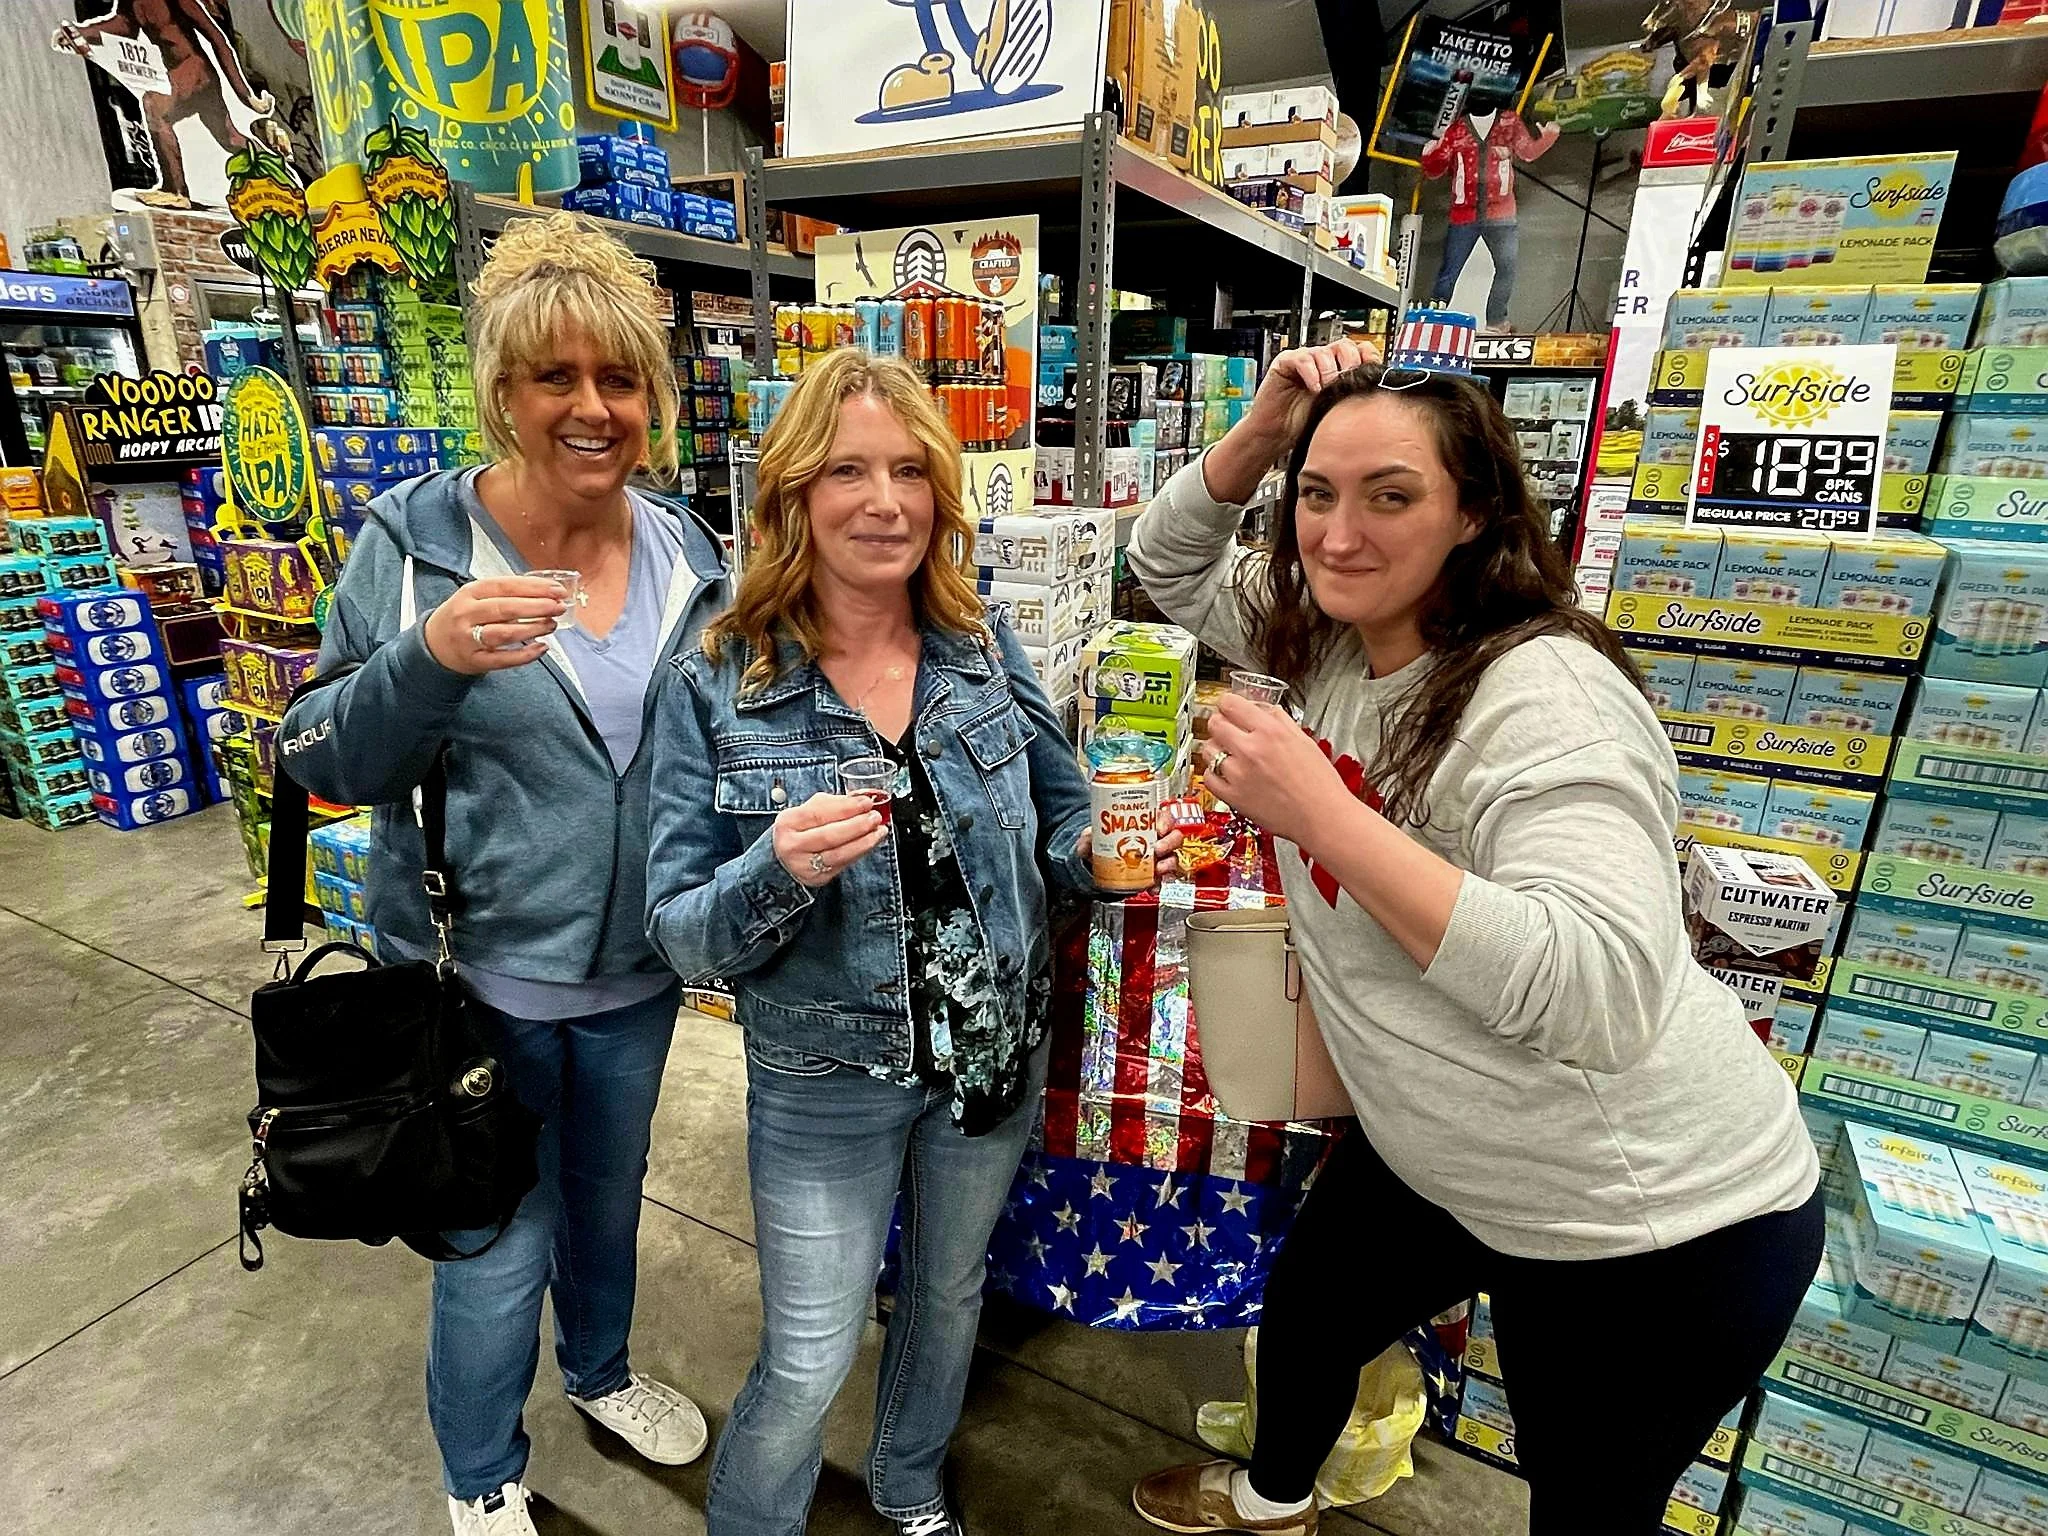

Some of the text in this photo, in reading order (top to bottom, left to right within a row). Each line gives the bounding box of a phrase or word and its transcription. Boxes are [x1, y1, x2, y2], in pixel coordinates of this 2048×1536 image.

[119, 40, 150, 64] 1812
[1440, 31, 1476, 52] TAKE
[1476, 40, 1493, 55] IT
[1492, 43, 1513, 59] TO
[380, 0, 537, 112] IPA
[1431, 46, 1512, 75] THE HOUSE
[1438, 82, 1461, 129] TRULY
[377, 171, 438, 192] SIERRA NEVADA
[1851, 177, 1948, 208] Surfside
[318, 229, 358, 259] SIERRA
[1839, 237, 1933, 249] LEMONADE PACK
[979, 258, 1012, 269] CRAFTED
[1624, 269, 1641, 288] R
[1675, 315, 1760, 325] LEMONADE PACK
[1771, 314, 1860, 324] LEMONADE PACK
[1872, 313, 1967, 324] LEMONADE PACK
[2008, 308, 2048, 318] GREEN
[99, 375, 214, 406] VOODOO
[1724, 374, 1870, 406] Surfside
[81, 407, 199, 441] RANGER
[242, 409, 285, 442] HAZY
[120, 440, 171, 459] HOPPY
[1900, 439, 1931, 448] PACK
[1967, 443, 2033, 452] GREEN TEA
[1700, 432, 1717, 488] SALE
[243, 453, 289, 503] IPA
[1825, 479, 1856, 491] 8PK
[1815, 491, 1863, 504] CANS
[1697, 508, 1753, 521] REGULAR
[1755, 510, 1791, 522] PRICE
[1020, 536, 1047, 558] 15
[1624, 557, 1712, 570] LEMONADE PACK
[1724, 563, 1819, 578] LEMONADE PACK
[1832, 571, 1933, 587] LEMONADE PACK
[1959, 582, 2027, 595] GREEN TEA
[1017, 599, 1044, 620] 15
[1657, 603, 1762, 634] Surfside
[1789, 615, 1875, 630] LEMONADE PACK
[1143, 671, 1173, 692] 15
[1657, 676, 1686, 686] PACK
[1696, 681, 1786, 697] LEMONADE PACK
[1142, 693, 1169, 706] PACK
[1799, 692, 1895, 711] LEMONADE PACK
[1922, 705, 2022, 723] GREEN TEA PACK
[1756, 731, 1837, 758] Surfside
[1111, 801, 1150, 812] ORANGE
[1730, 797, 1759, 810] PACK
[1100, 809, 1157, 836] SMASH
[1771, 805, 1863, 826] LEMONADE PACK
[1889, 823, 1985, 843] GREEN TEA PACK
[2002, 839, 2041, 851] GREEN
[1720, 886, 1830, 916] CUTWATER
[1917, 873, 2035, 910] Surfside
[1727, 911, 1811, 932] ESPRESSO MARTINI
[1857, 931, 1947, 953] GREEN TEA PACK
[1965, 950, 2030, 970] GREEN TEA
[1778, 1021, 1805, 1032] PACK
[1826, 1032, 1914, 1056] GREEN TEA PACK
[1929, 1055, 2022, 1081] GREEN TEA PACK
[1864, 1136, 1944, 1165] Surfside
[1876, 1249, 1977, 1283] GREEN TEA PACK
[1995, 1286, 2035, 1302] GREEN
[1828, 1332, 1850, 1347] TEA
